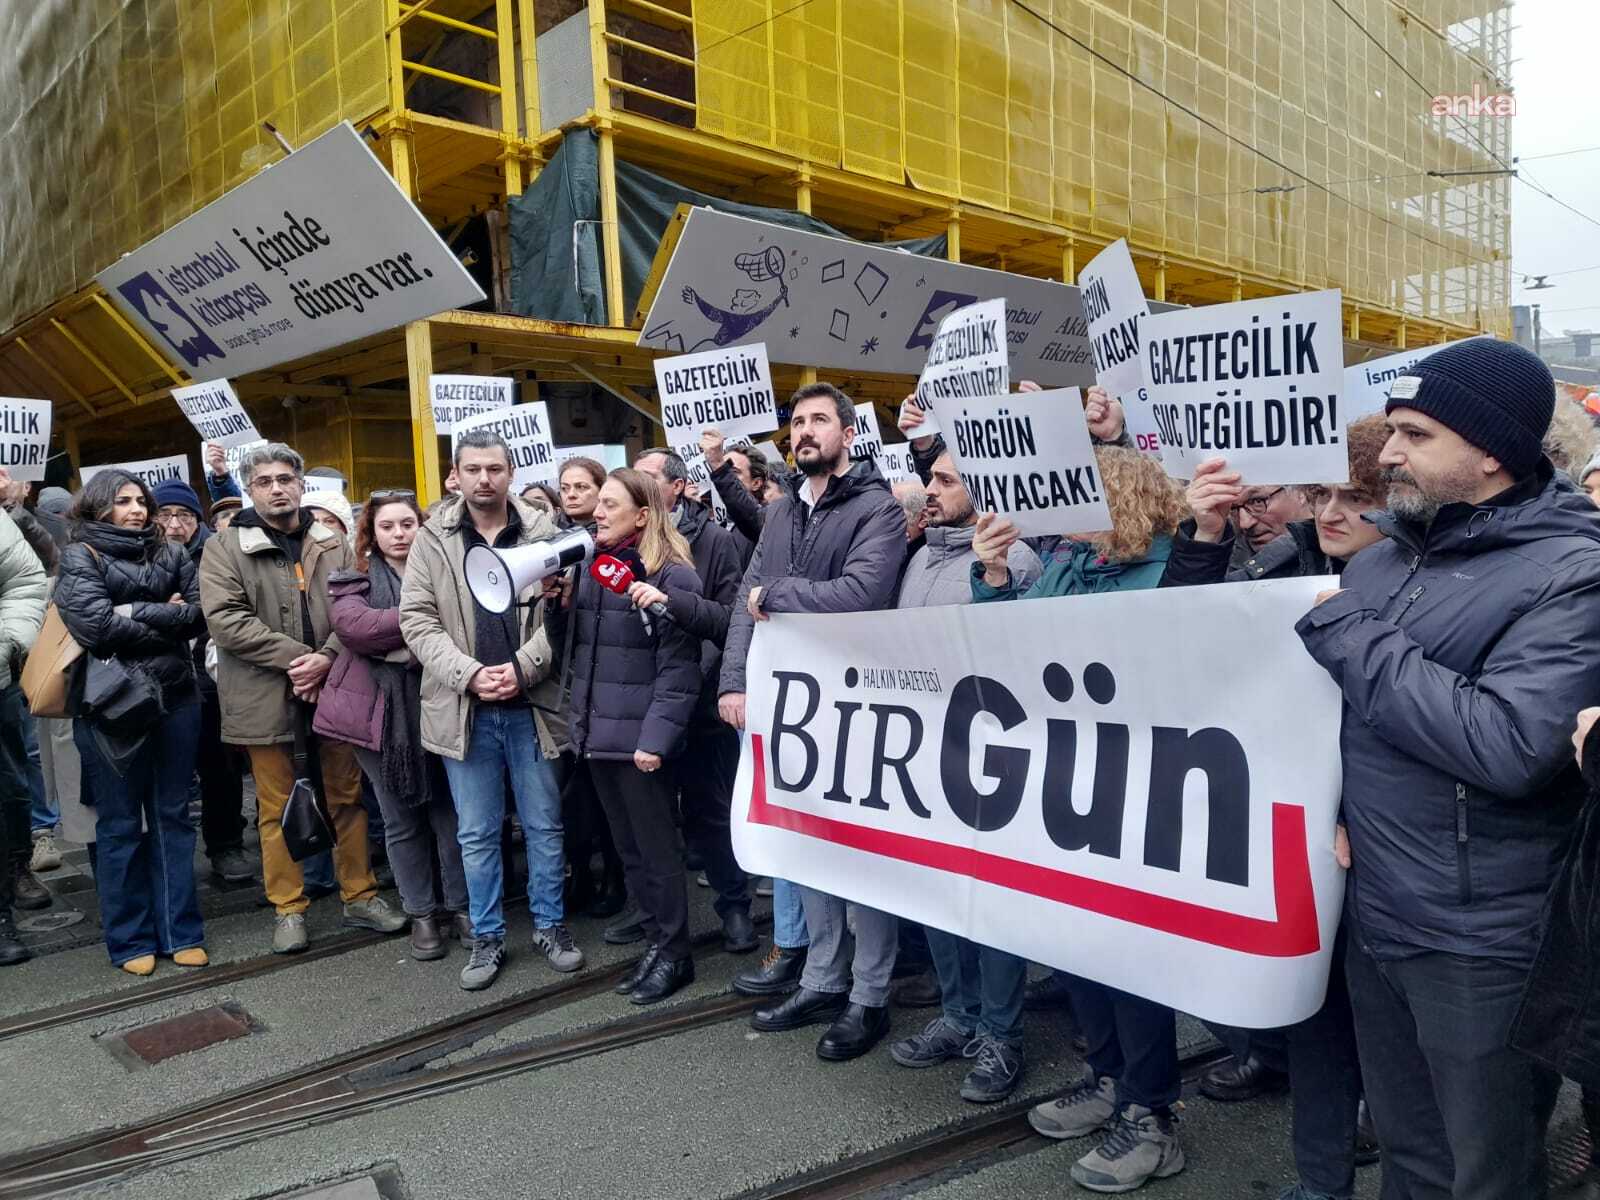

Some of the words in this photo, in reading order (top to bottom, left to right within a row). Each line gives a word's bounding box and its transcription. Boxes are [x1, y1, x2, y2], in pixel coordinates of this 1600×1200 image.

[158, 240, 241, 297] istanbul
[232, 210, 331, 276] İçinde
[289, 278, 379, 320] dünya
[365, 251, 434, 292] var.
[664, 353, 761, 395] GAZETECİLİK
[1149, 311, 1320, 386] GAZETECİLİK
[435, 381, 506, 402] GAZETECİLİK
[664, 403, 693, 431] SUÇ
[694, 386, 773, 425] DEĞİLDİR!
[953, 407, 1038, 459] BİRGÜN
[1152, 398, 1184, 458] SUÇ
[1185, 385, 1339, 451] DEĞİLDİR!
[863, 667, 896, 689] HALKIN
[897, 667, 943, 693] GAZETESİ
